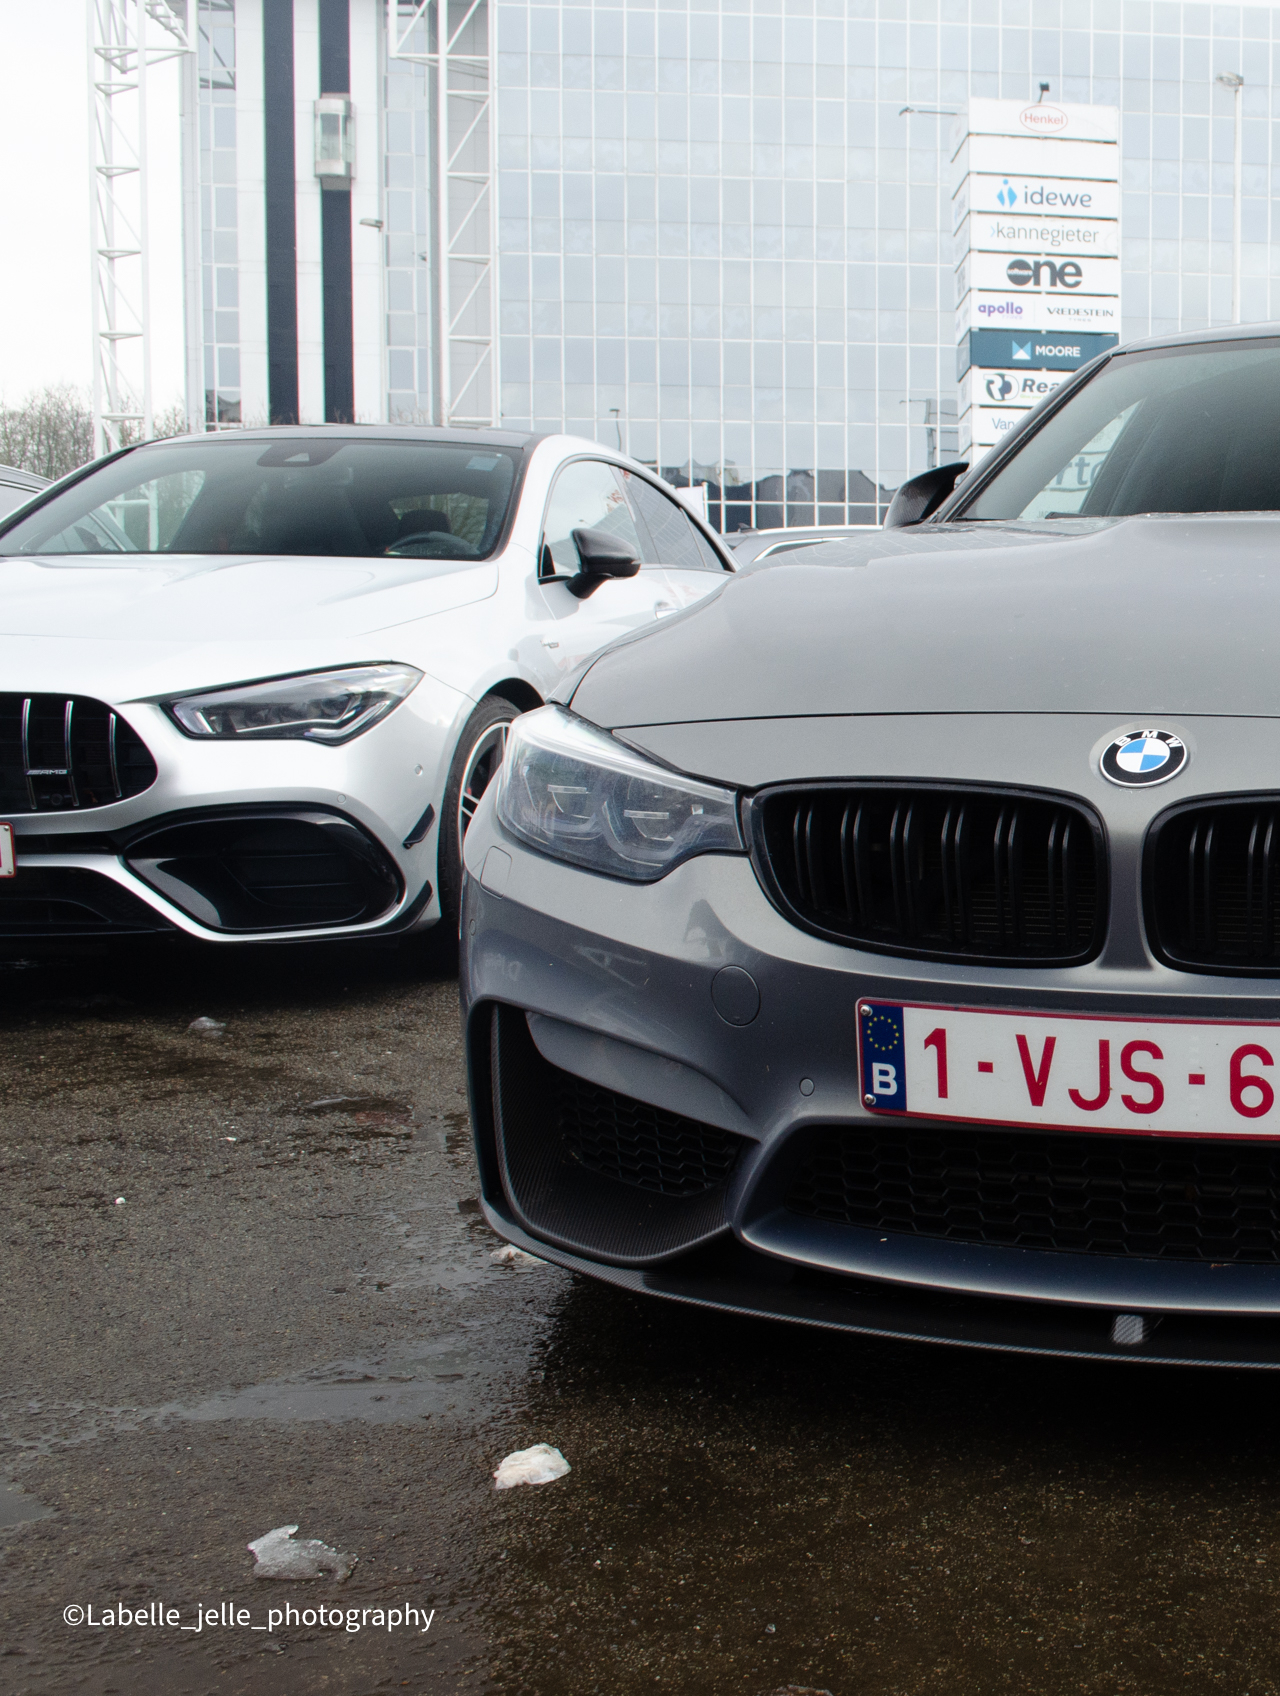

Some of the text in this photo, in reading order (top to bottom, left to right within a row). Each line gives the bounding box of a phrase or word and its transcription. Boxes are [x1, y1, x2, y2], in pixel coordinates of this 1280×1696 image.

[1024, 113, 1064, 125] Henkel
[1023, 185, 1092, 208] idewe
[996, 222, 1100, 247] kannegieter
[978, 301, 1023, 317] apollo
[1046, 306, 1114, 317] VREDESTEIN
[1035, 345, 1081, 357] MOORE
[1114, 730, 1182, 748] BMW
[871, 1062, 898, 1096] B
